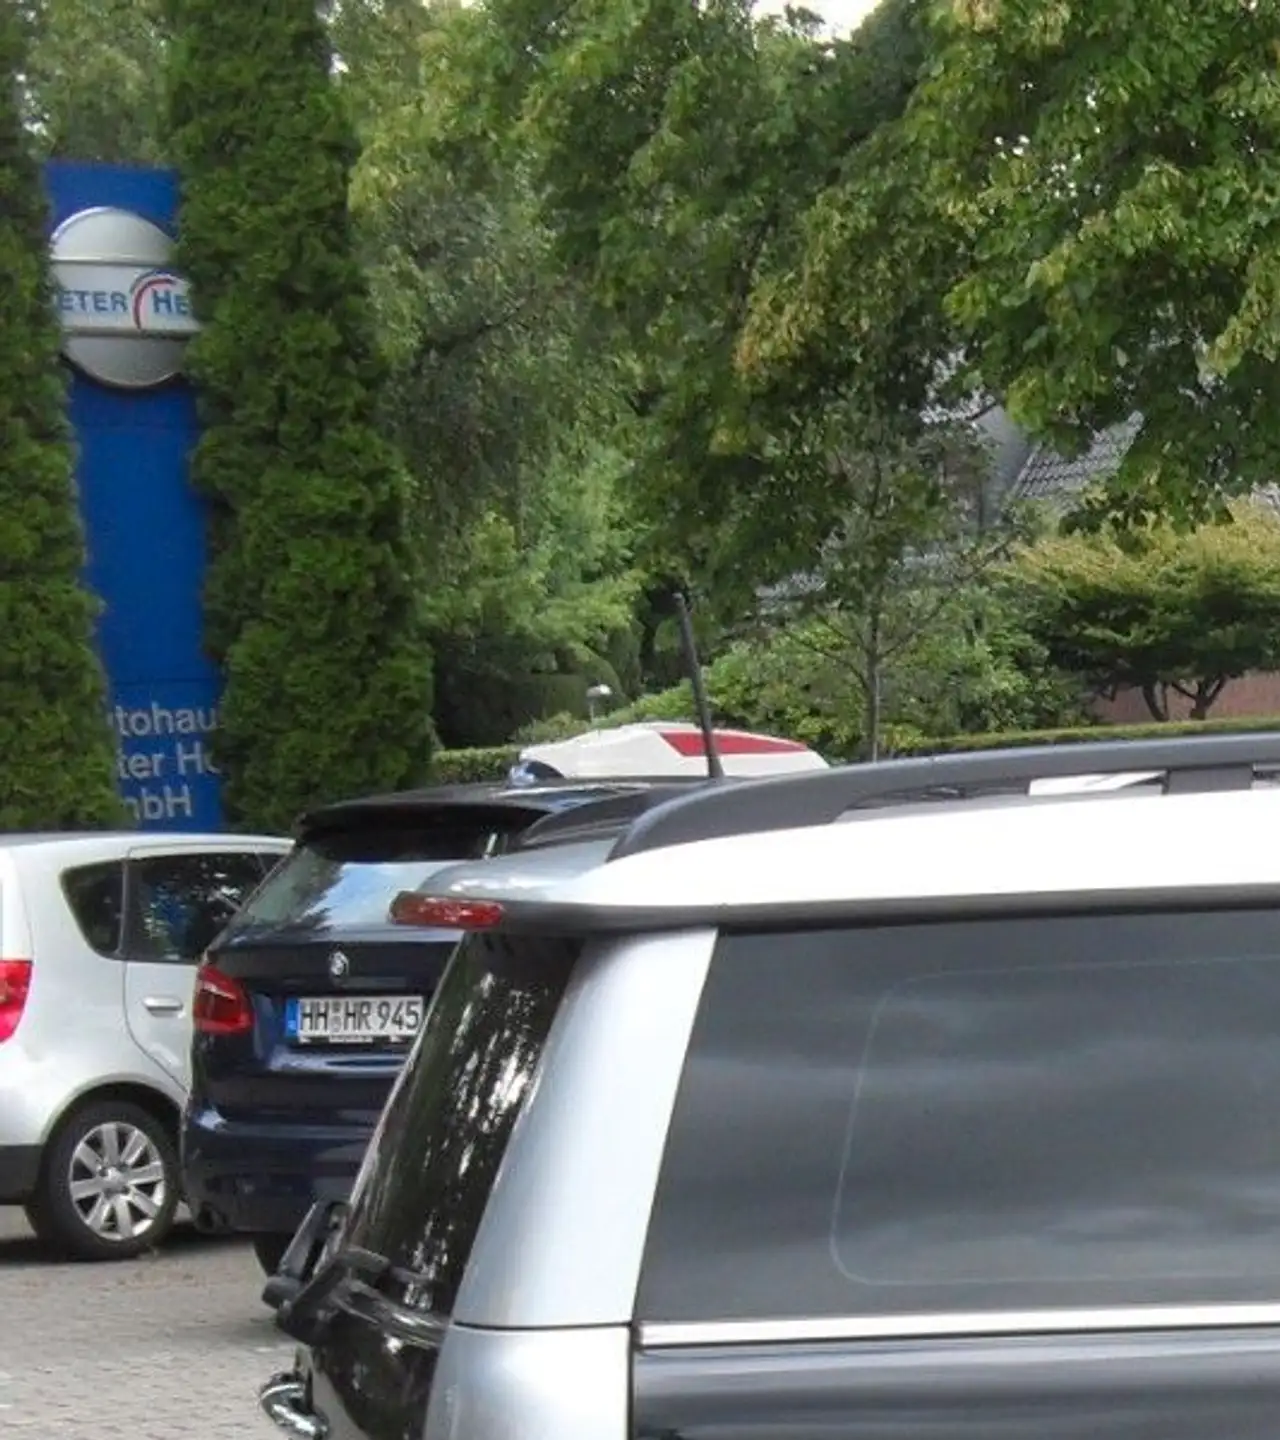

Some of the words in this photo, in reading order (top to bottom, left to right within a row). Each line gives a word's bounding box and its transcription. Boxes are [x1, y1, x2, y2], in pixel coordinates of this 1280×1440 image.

[107, 701, 217, 736] tohau
[299, 1001, 328, 1031] HH
[344, 1001, 372, 1031] HR
[378, 1001, 420, 1030] 945
